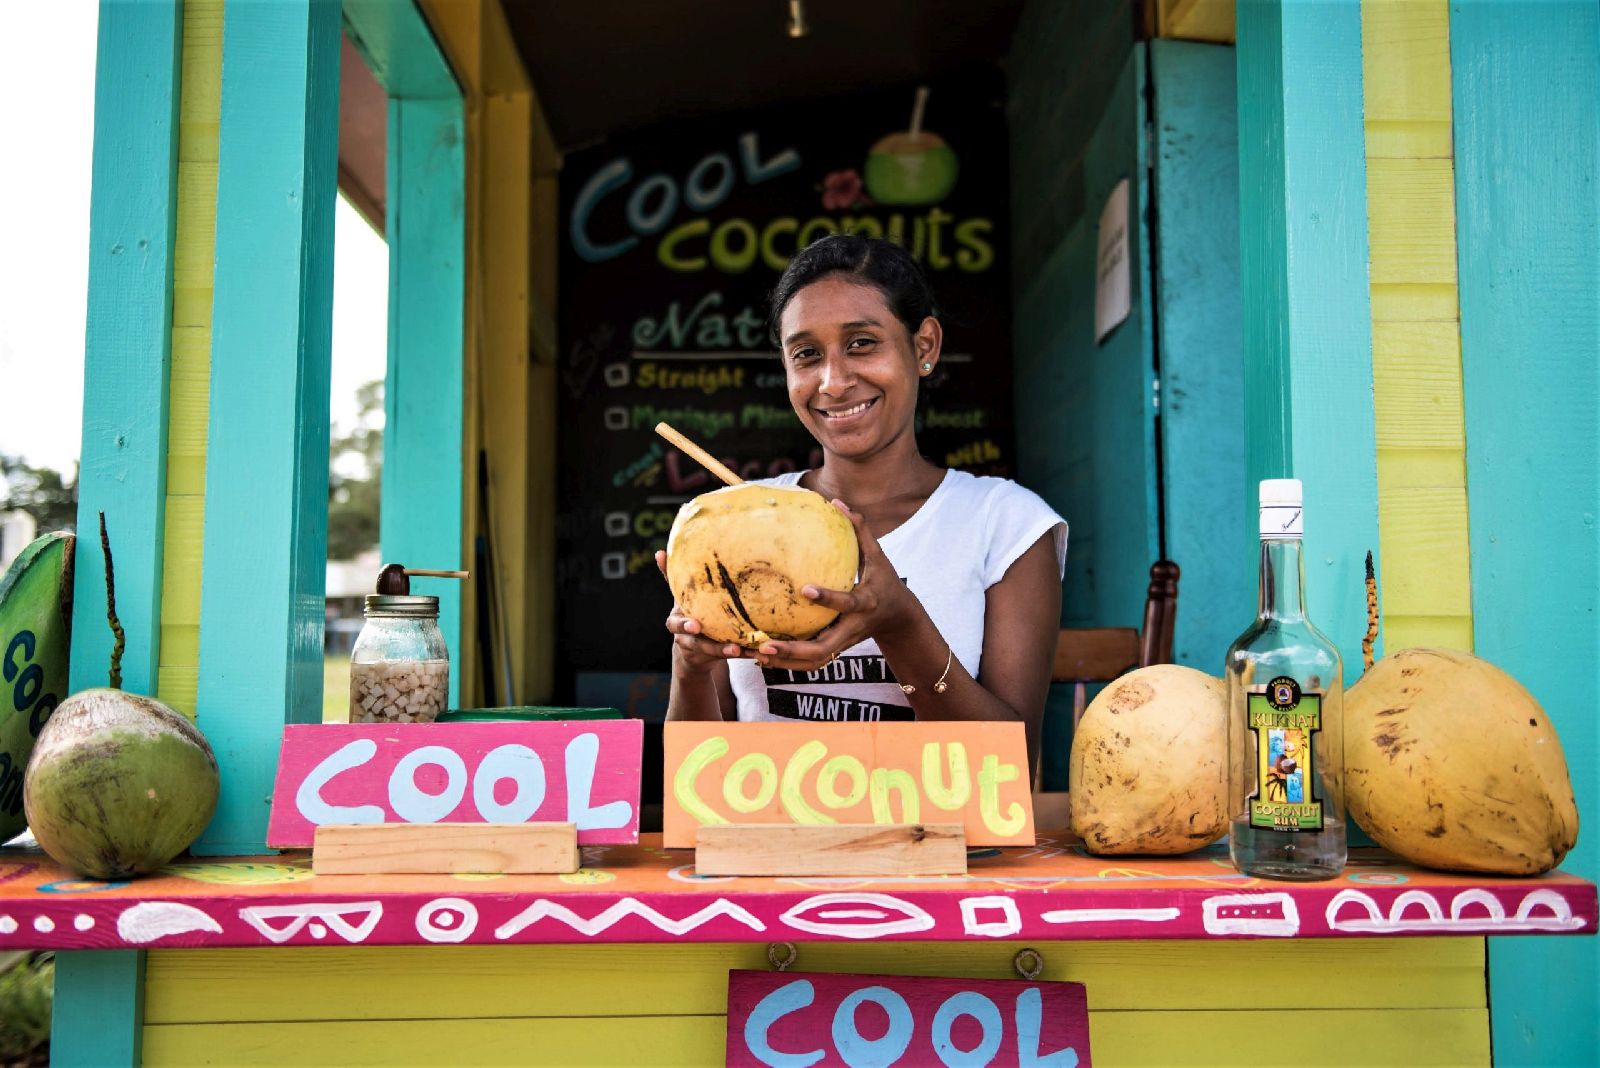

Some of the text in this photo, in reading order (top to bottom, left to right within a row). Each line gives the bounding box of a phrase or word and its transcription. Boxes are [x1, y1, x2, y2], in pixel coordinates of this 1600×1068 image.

[634, 362, 745, 395] Straight
[796, 694, 881, 722] WANT TO
[1253, 712, 1317, 728] KUKNAT
[295, 732, 633, 831] COOL
[1255, 804, 1318, 818] COCONUT
[1274, 816, 1299, 826] RUM
[743, 978, 1080, 1068] COOL
